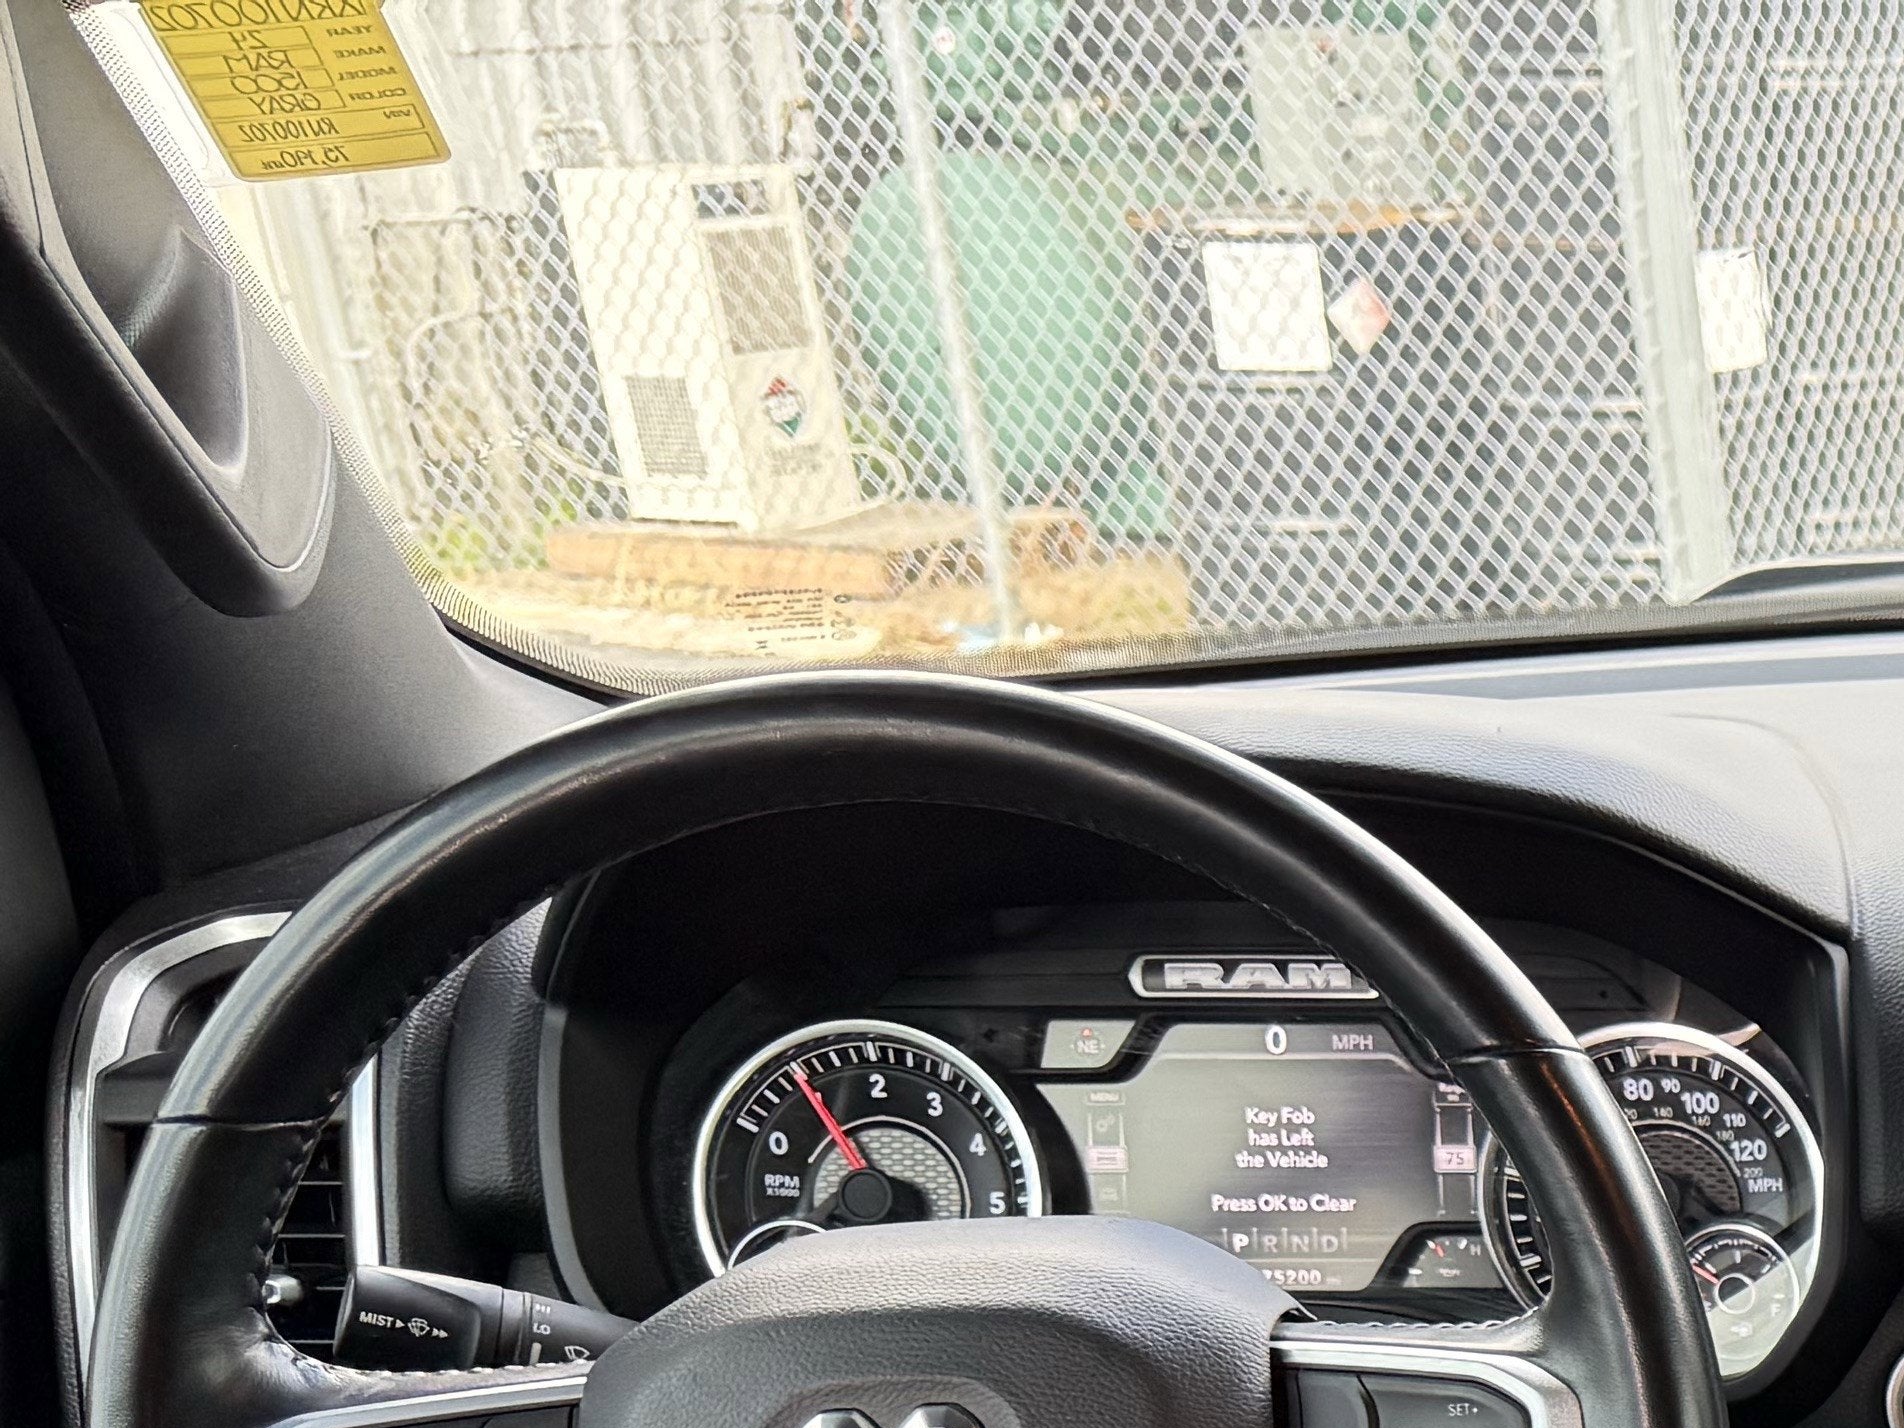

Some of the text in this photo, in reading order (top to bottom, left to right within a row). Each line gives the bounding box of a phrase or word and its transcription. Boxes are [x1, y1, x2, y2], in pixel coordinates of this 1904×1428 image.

[1163, 963, 1353, 990] RAM
[1077, 1039, 1100, 1053] NE
[1265, 1024, 1374, 1055] 0 MPH
[869, 1073, 888, 1099] 2
[1623, 1078, 1654, 1101] 80
[1661, 1079, 1681, 1093] 90
[925, 1092, 944, 1117] 3
[1681, 1092, 1720, 1115] 100
[1245, 1105, 1316, 1128] Key Fob
[1722, 1113, 1747, 1128] 110
[768, 1130, 789, 1155] 0
[969, 1132, 987, 1157] 4
[1248, 1128, 1315, 1147] has Left
[1235, 1150, 1329, 1168] the Vehicle
[1445, 1152, 1465, 1165] 75
[1730, 1139, 1768, 1162] 120
[764, 1173, 800, 1188] RPM
[1748, 1178, 1784, 1193] MPH
[989, 1191, 1007, 1215] 5
[1210, 1193, 1357, 1213] Press OK to Clear
[1232, 1232, 1340, 1255] P R N D
[359, 1311, 396, 1328] MIST
